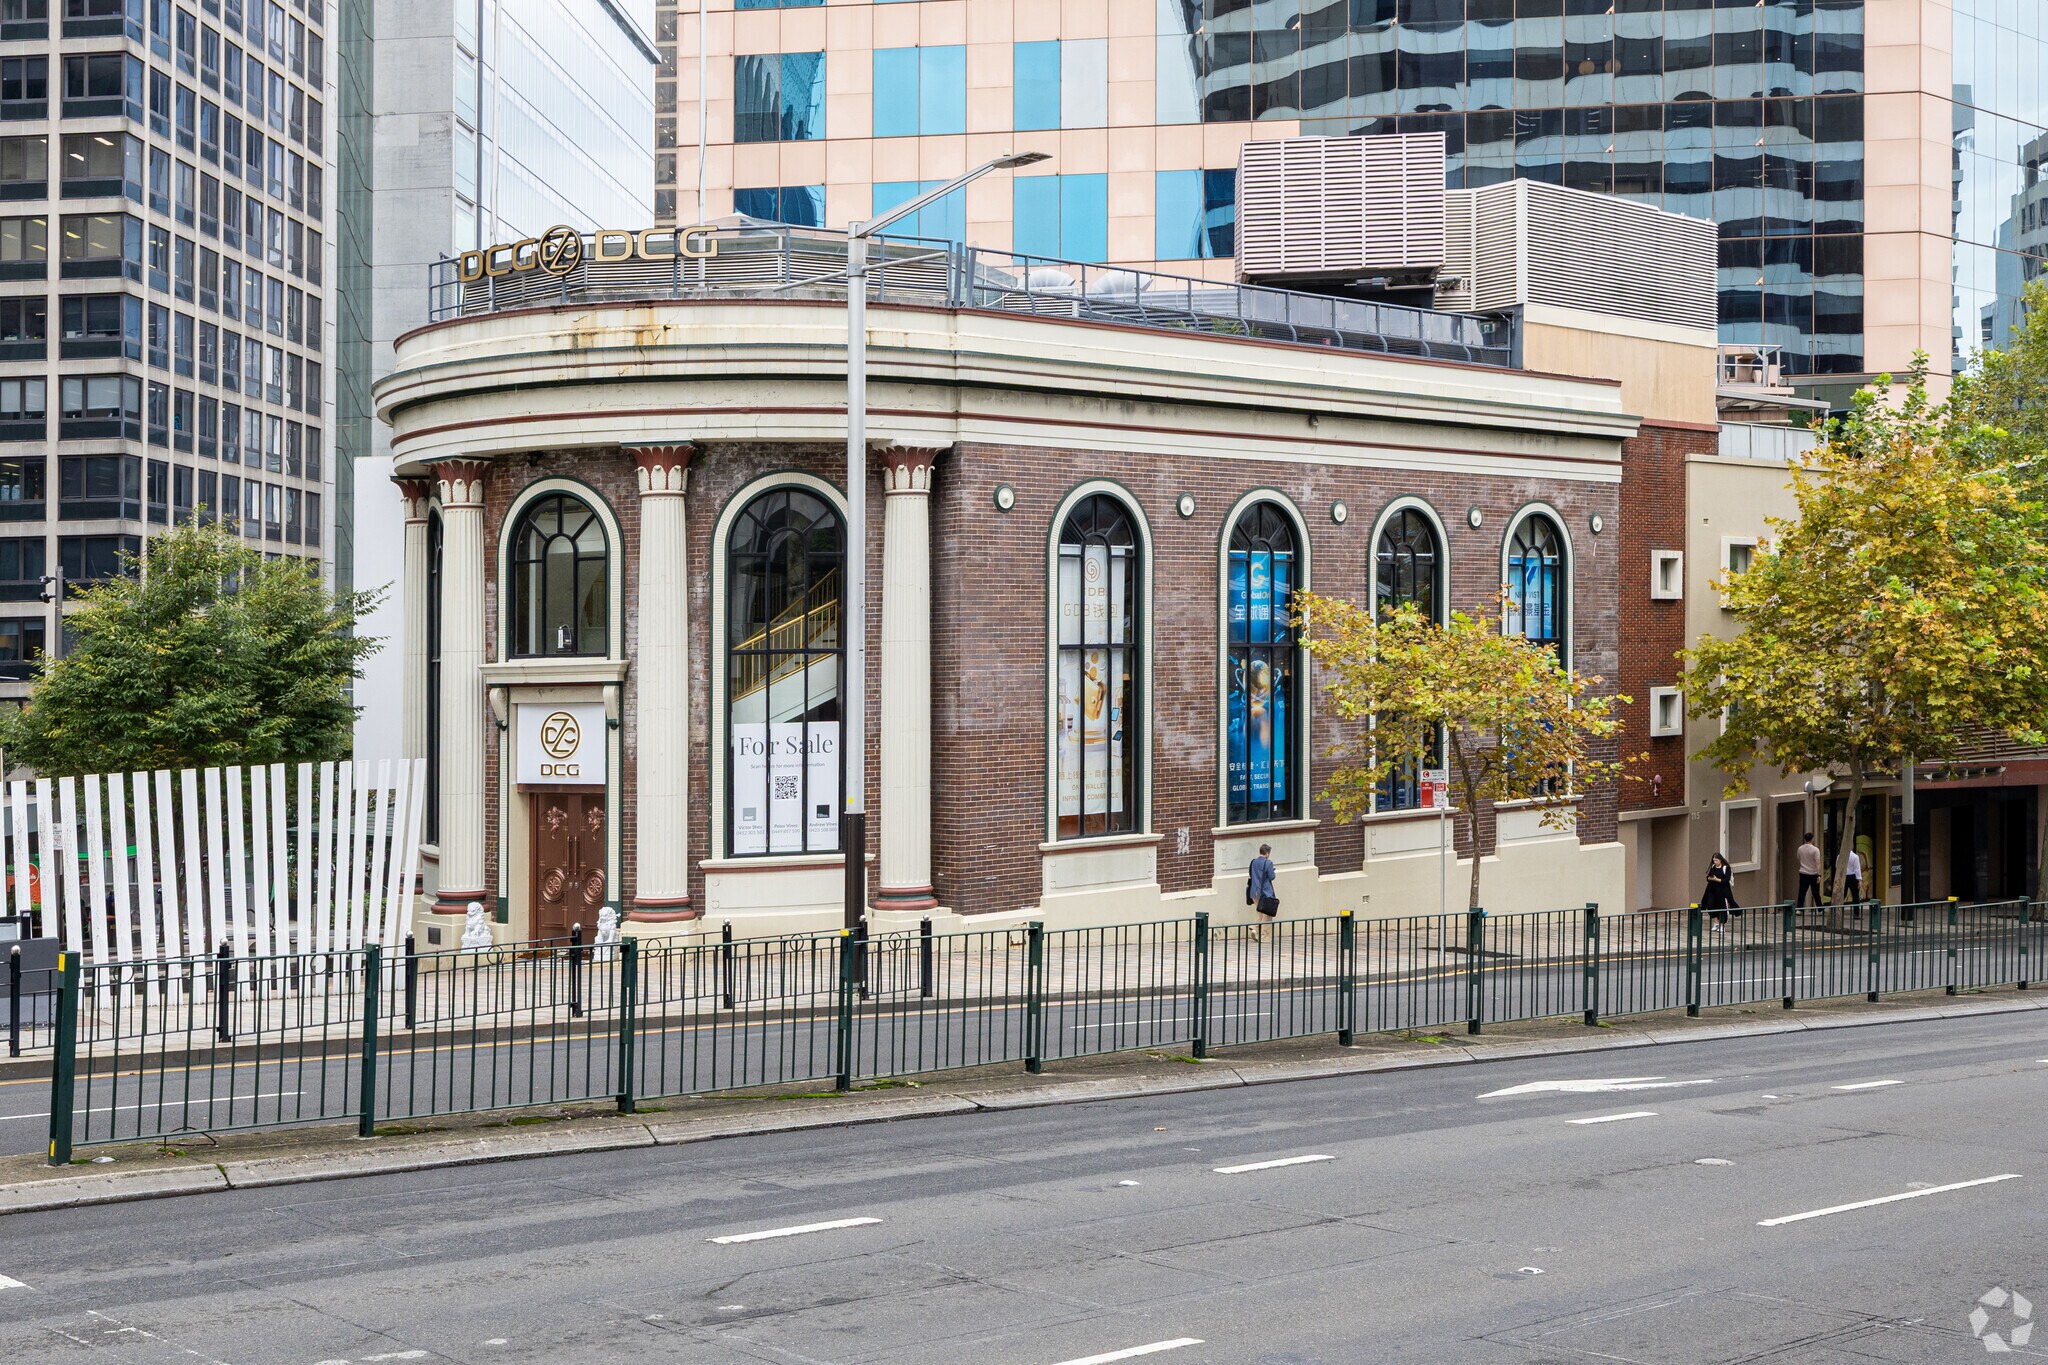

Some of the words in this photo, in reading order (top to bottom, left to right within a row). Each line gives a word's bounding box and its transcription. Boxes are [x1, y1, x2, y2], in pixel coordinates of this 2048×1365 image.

[595, 225, 719, 261] DCG
[460, 237, 538, 283] DCG
[739, 737, 779, 756] For
[786, 734, 833, 755] Sale
[541, 764, 579, 776] DCG
[1691, 811, 1700, 820] 115
